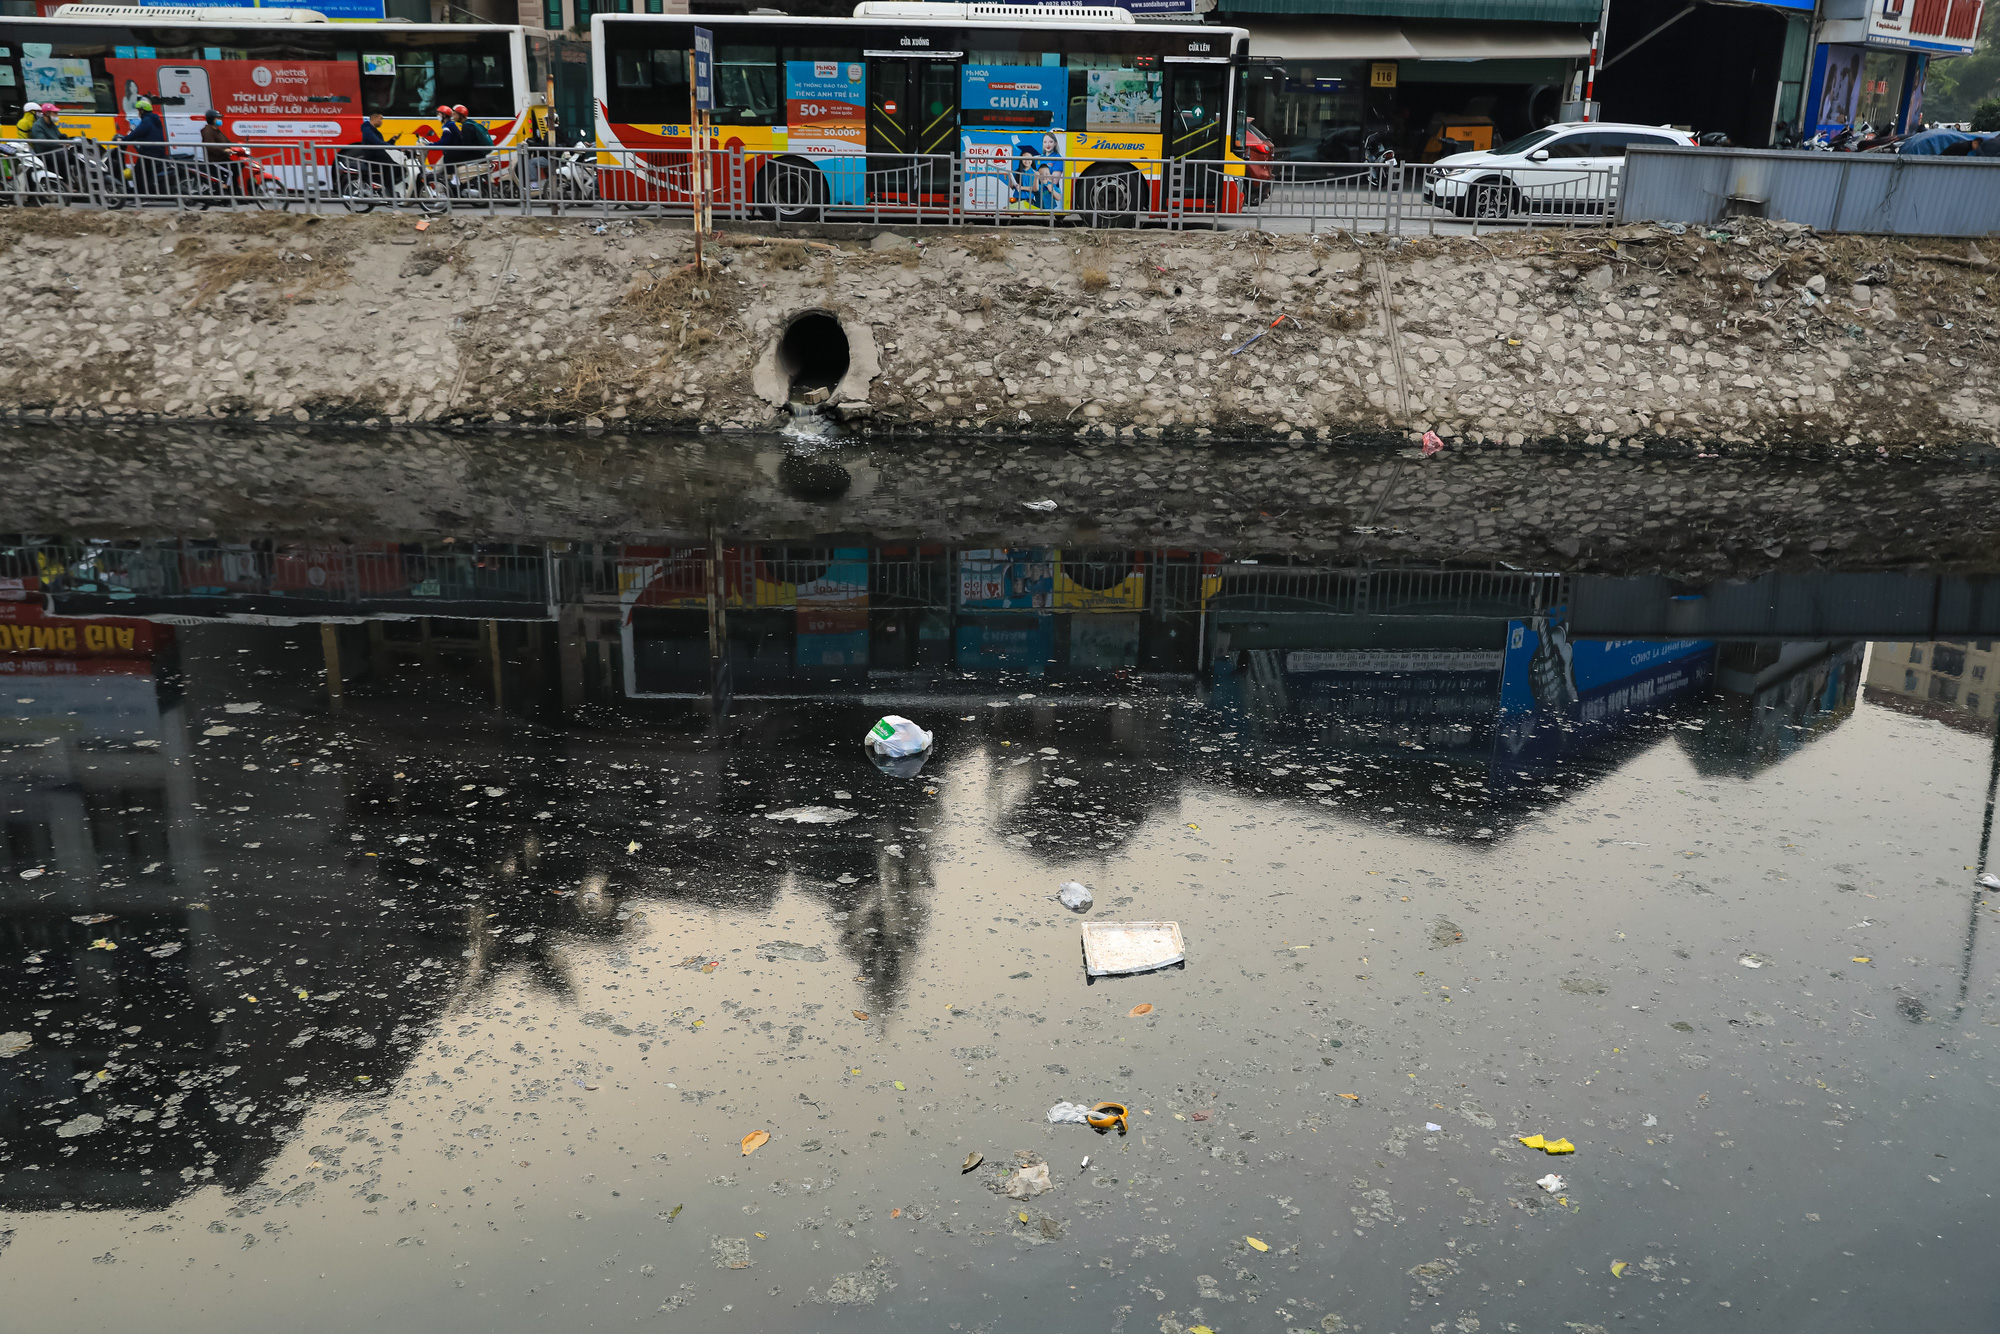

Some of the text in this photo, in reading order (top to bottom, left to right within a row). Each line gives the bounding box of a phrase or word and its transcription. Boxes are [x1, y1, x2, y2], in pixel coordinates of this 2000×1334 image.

[1376, 72, 1392, 82] 116
[990, 91, 1039, 108] CHUẨN
[800, 104, 827, 116] 50+
[662, 126, 678, 136] 29B
[1091, 140, 1145, 150] HANOIBUS
